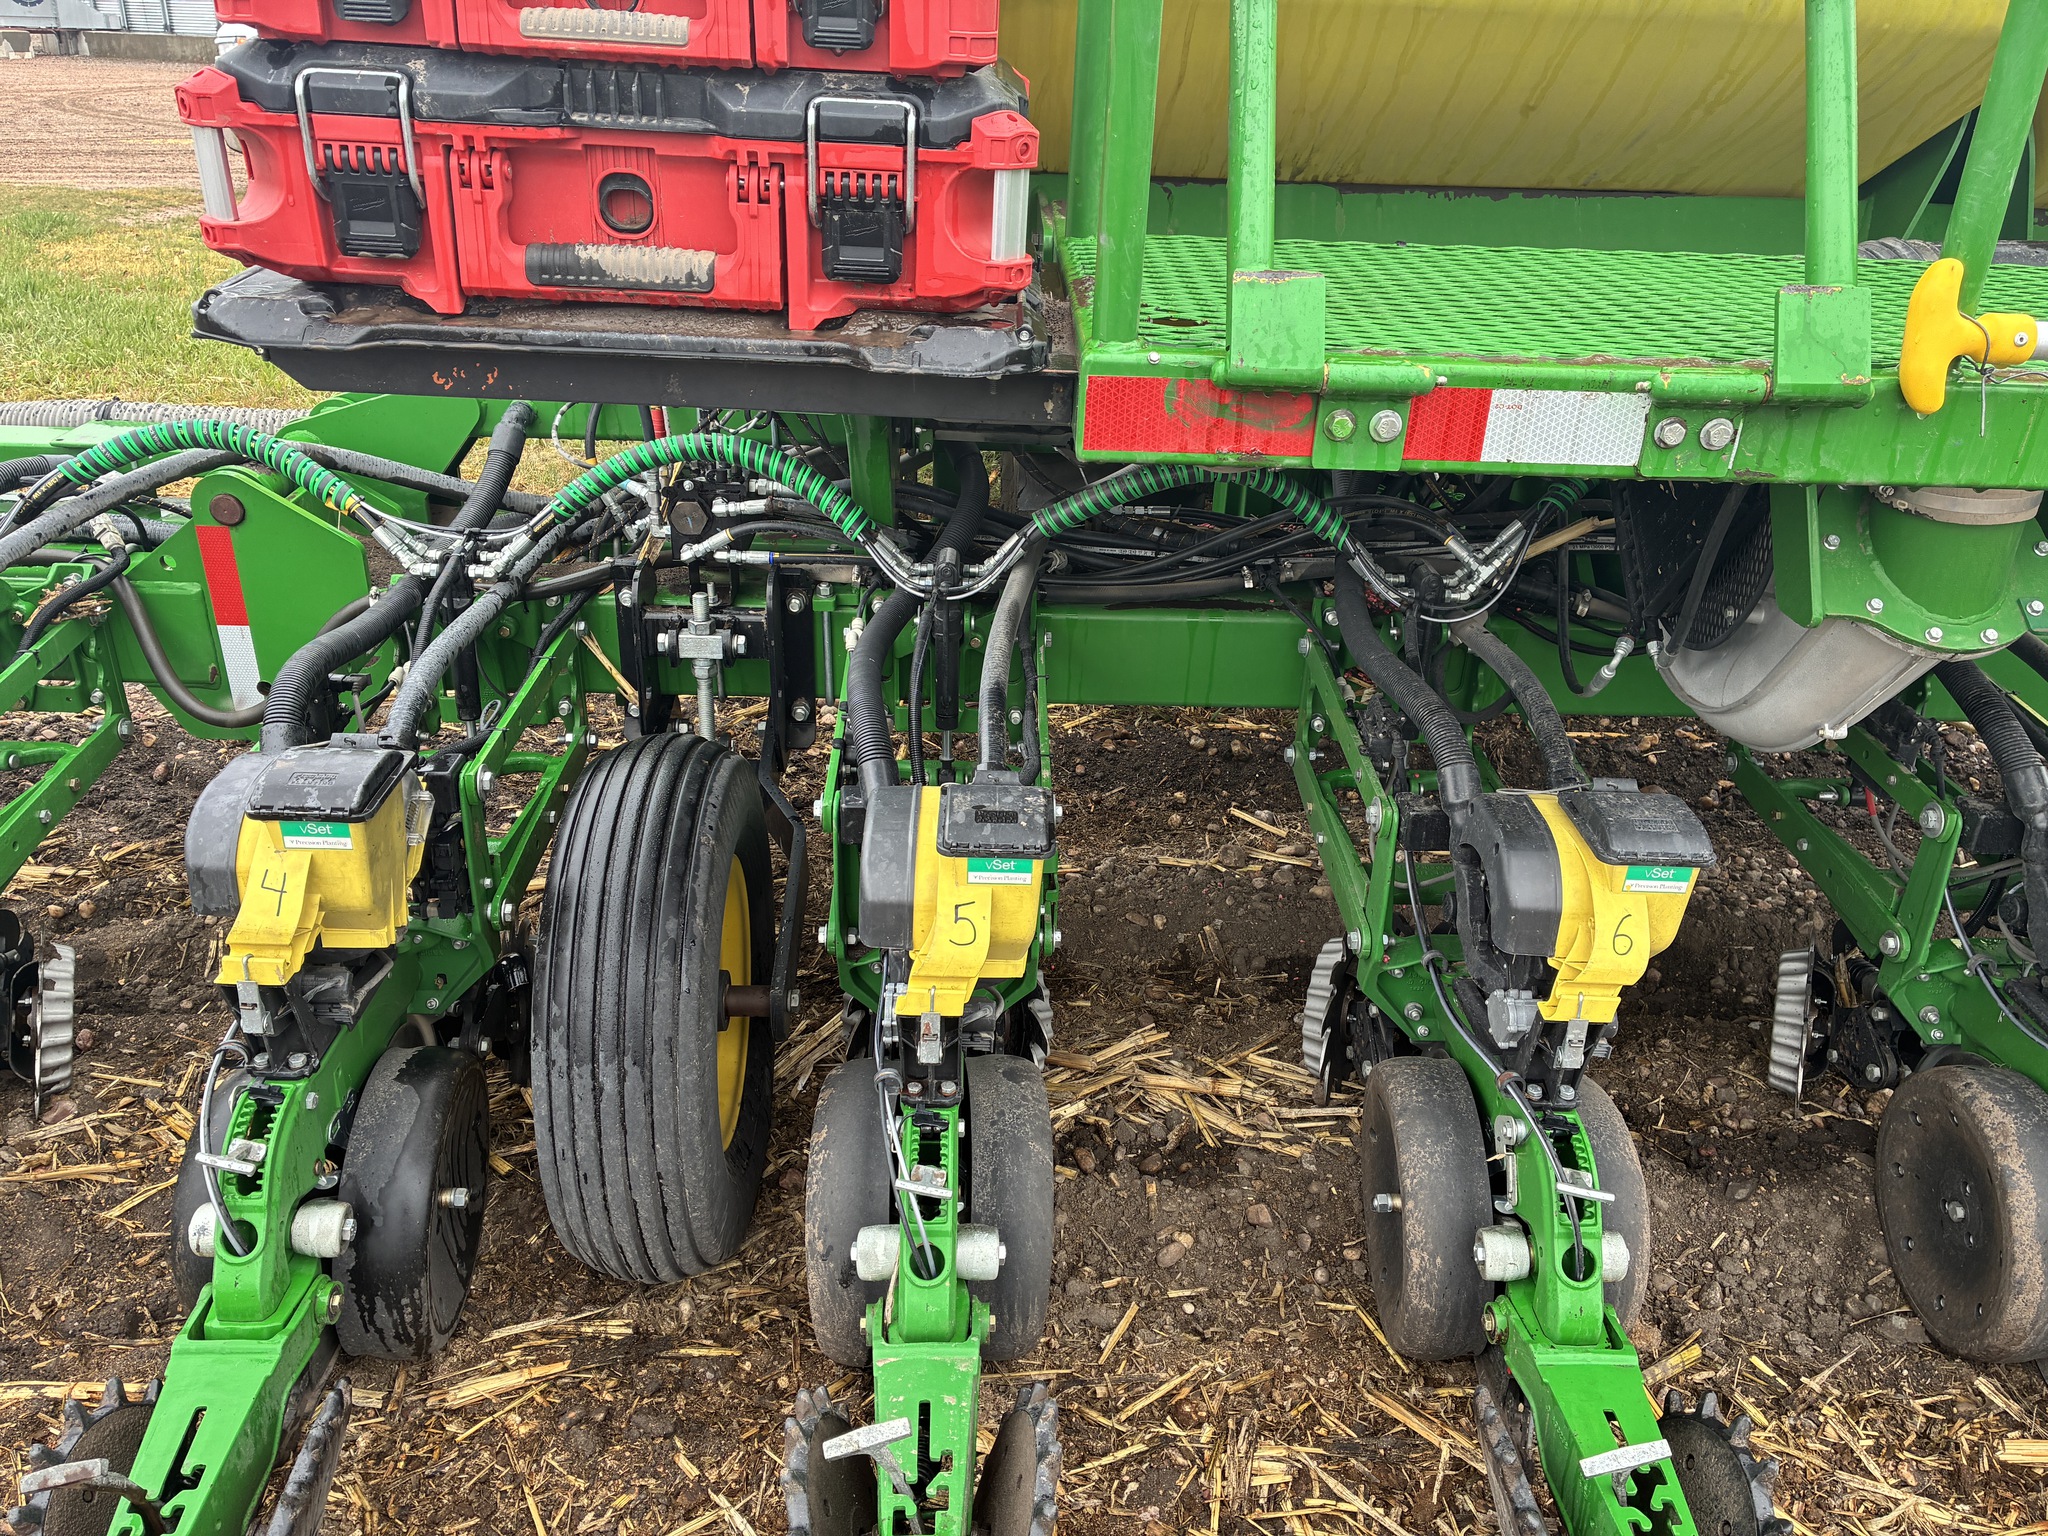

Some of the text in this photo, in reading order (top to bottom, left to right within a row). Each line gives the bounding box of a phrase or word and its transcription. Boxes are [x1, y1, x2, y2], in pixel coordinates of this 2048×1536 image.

[1494, 403, 1523, 411] DOT-C2
[299, 823, 333, 835] vSet
[985, 859, 1016, 871] vSet
[1645, 867, 1675, 879] vSet
[261, 869, 287, 917] 4
[949, 901, 977, 946] 5
[1612, 914, 1633, 956] 6
